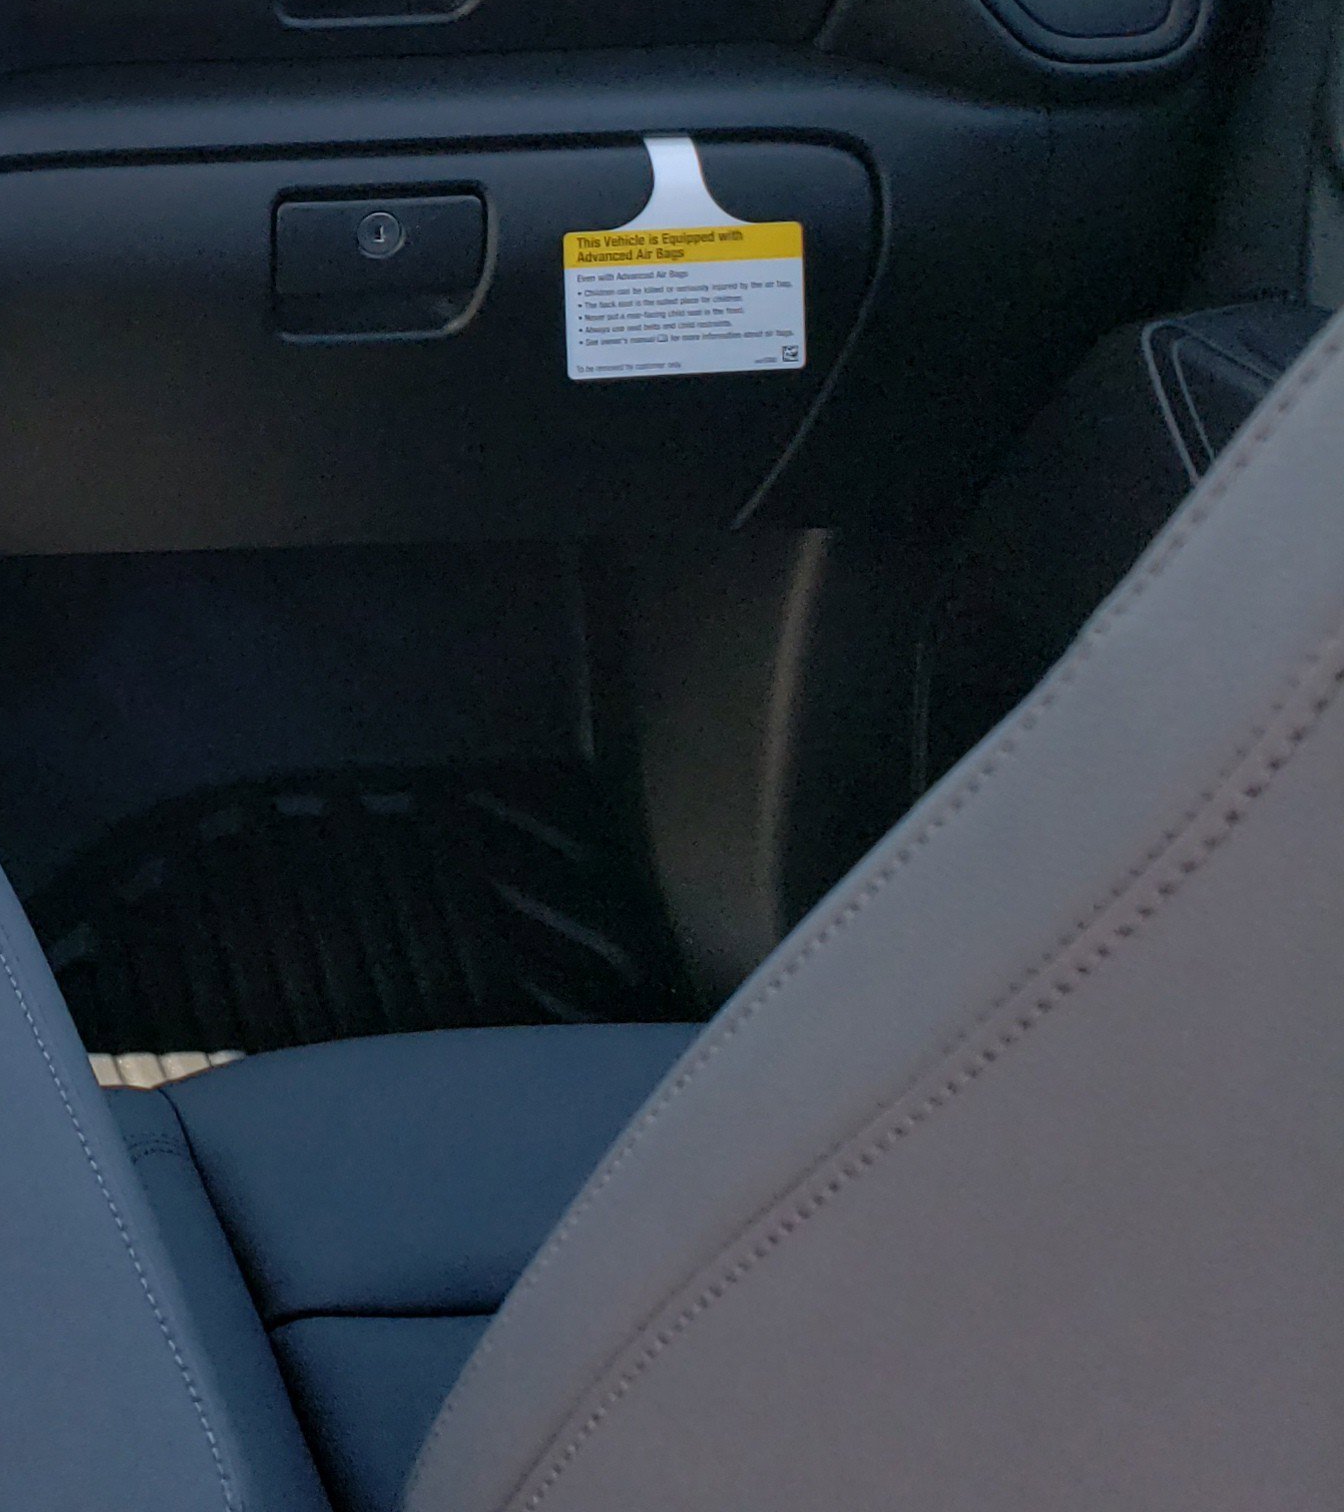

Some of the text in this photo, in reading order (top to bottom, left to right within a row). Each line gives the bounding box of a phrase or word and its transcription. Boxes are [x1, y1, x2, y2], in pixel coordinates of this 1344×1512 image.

[576, 230, 744, 249] This Vehicle is Equipped with
[576, 248, 685, 263] Advanced Air Bags
[616, 271, 654, 281] Advanced
[656, 270, 667, 279] Air
